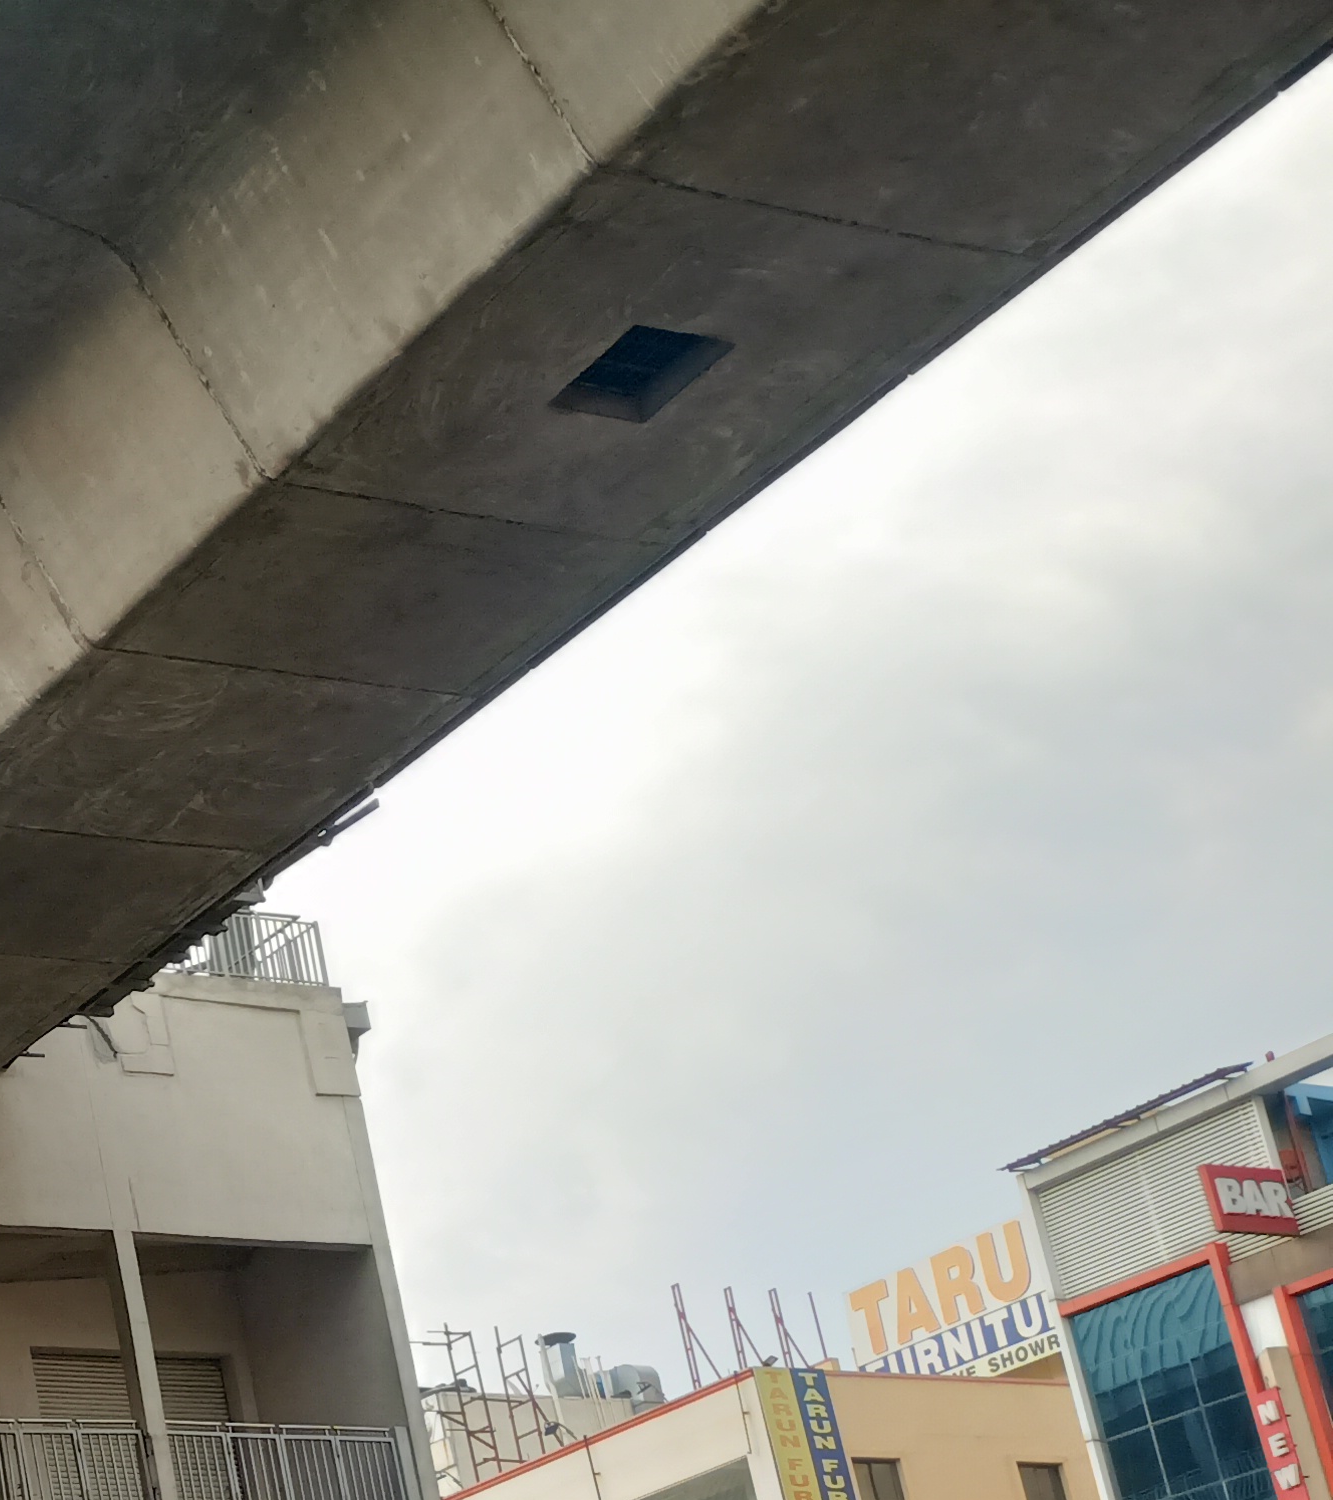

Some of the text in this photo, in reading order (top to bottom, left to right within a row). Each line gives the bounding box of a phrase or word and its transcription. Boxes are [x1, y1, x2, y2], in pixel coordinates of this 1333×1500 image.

[1214, 1177, 1295, 1219] BAR
[765, 1371, 801, 1448] TARUN
[798, 1372, 837, 1449] TARUN
[1257, 1400, 1301, 1490] NEW
